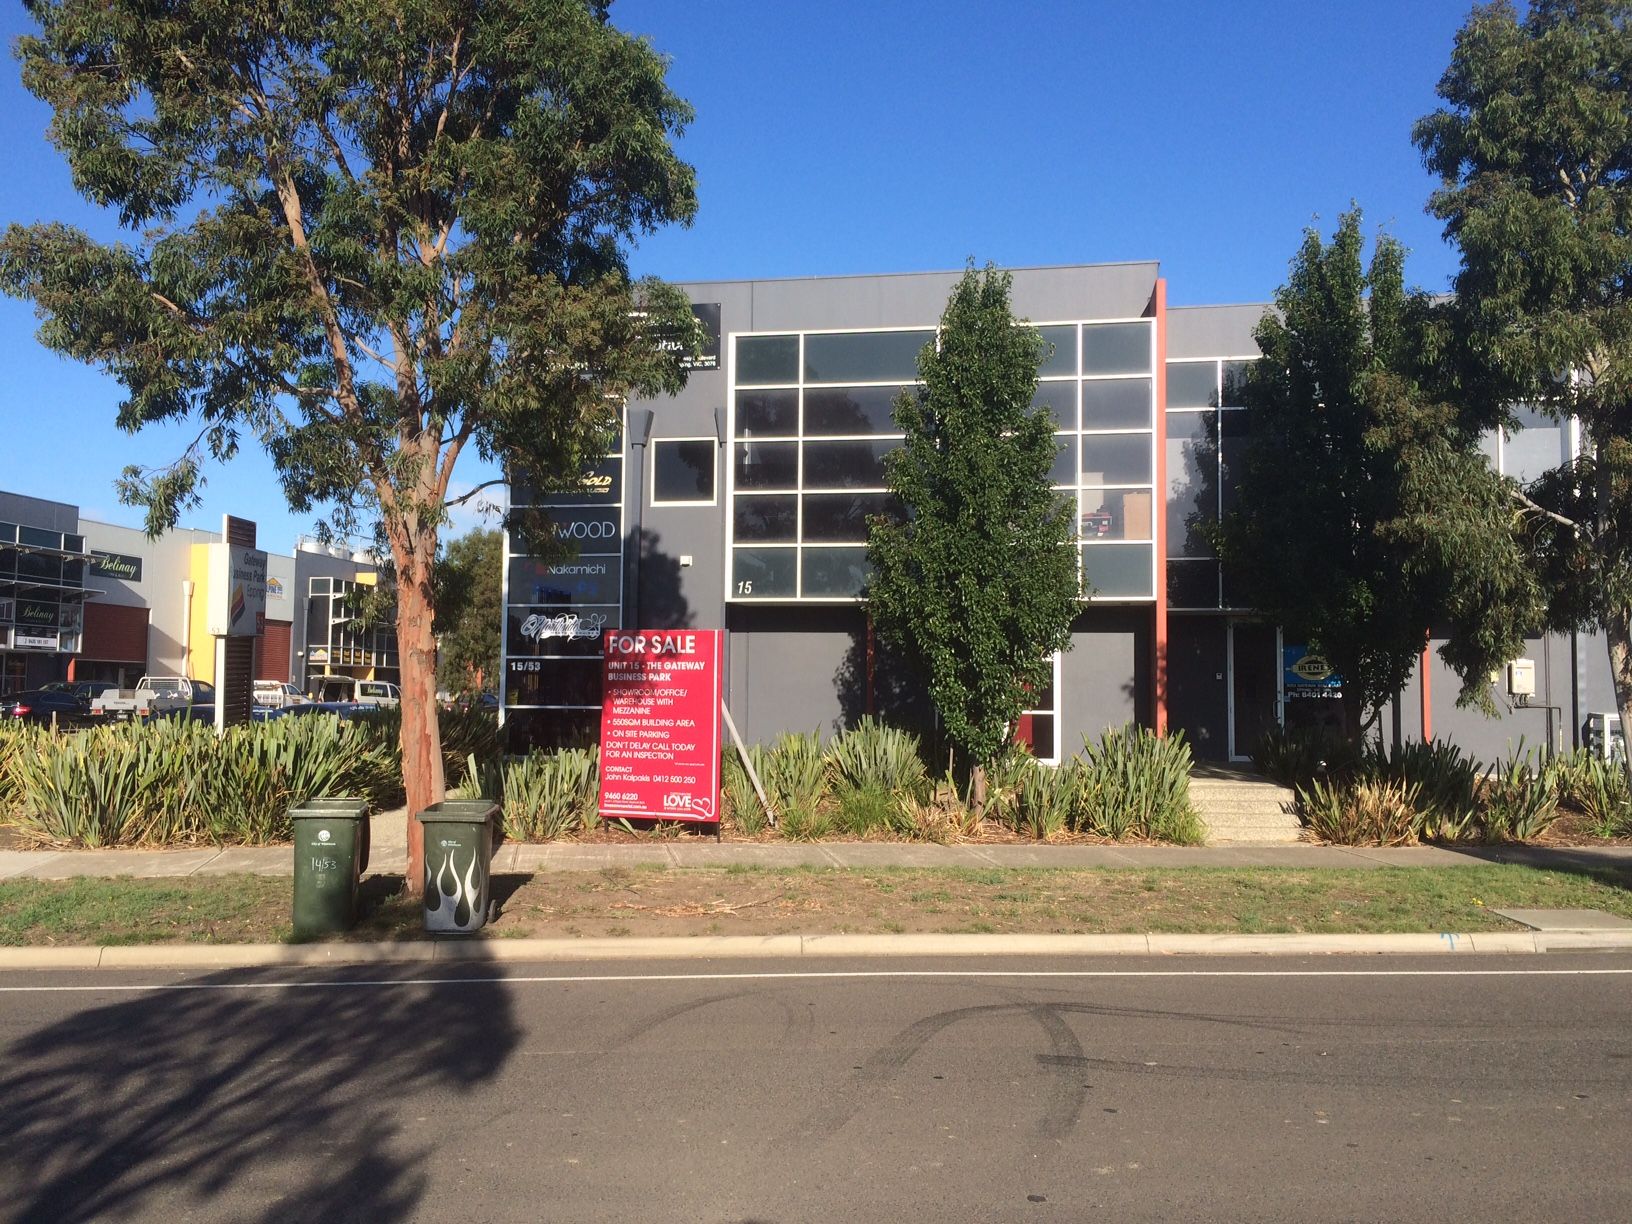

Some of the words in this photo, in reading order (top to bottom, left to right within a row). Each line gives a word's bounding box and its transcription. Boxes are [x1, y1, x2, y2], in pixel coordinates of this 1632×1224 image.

[100, 555, 136, 578] Belinay
[547, 563, 606, 575] Nakamichi
[737, 580, 753, 594] 15
[609, 635, 646, 654] FOR
[651, 635, 696, 654] SALE
[510, 661, 541, 671] 15/53
[608, 662, 628, 670] UNIT
[630, 662, 640, 670] 15
[646, 662, 662, 670] THE
[664, 662, 706, 670] GATEWAY
[608, 672, 647, 681] BUSINESS
[648, 673, 672, 681] PARK
[613, 689, 688, 697] SHOWROOM/OFFICE/
[613, 707, 651, 715] MEZZANINE
[613, 718, 641, 726] 550SQM
[642, 719, 674, 727] BUILDING
[625, 730, 638, 738] SITE
[639, 730, 670, 739] PARKING
[606, 741, 628, 749] DON'T
[629, 741, 651, 750] DELAY
[652, 742, 670, 751] CALL
[671, 743, 696, 751] TODAY
[606, 750, 620, 758] FOR
[633, 751, 674, 760] INSPECTION
[605, 773, 622, 781] John
[653, 775, 669, 783] 0412
[670, 775, 683, 783] 500
[683, 776, 696, 784] 250
[604, 792, 621, 800] 9460
[622, 792, 638, 800] 6220
[663, 794, 692, 808] LOVE
[311, 857, 337, 872] 14/53
